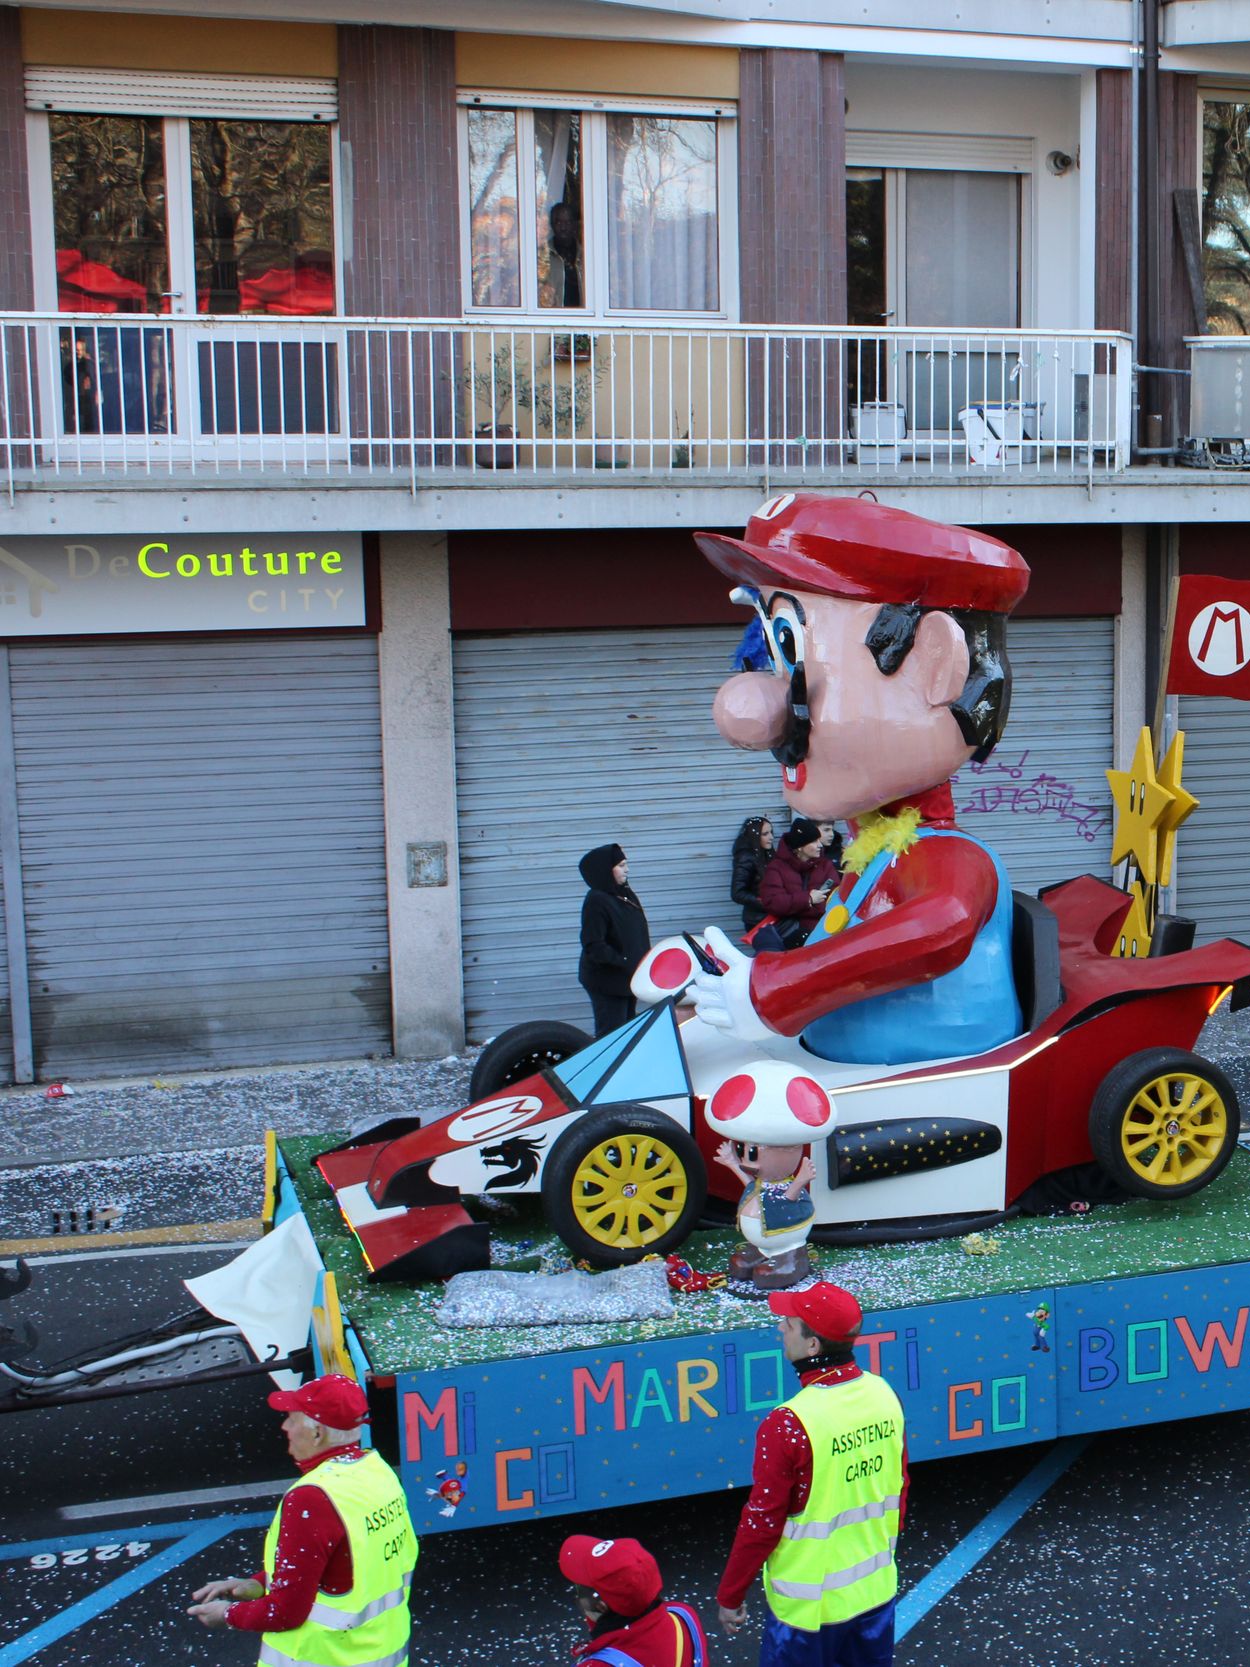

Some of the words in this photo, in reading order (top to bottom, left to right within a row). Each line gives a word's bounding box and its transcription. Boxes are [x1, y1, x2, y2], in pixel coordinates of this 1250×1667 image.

[247, 588, 344, 613] CITY
[831, 1418, 897, 1457] ASSISTENZA
[845, 1454, 883, 1483] CARRO
[365, 1496, 405, 1536] ASSISTE
[30, 1541, 151, 1569] 4226
